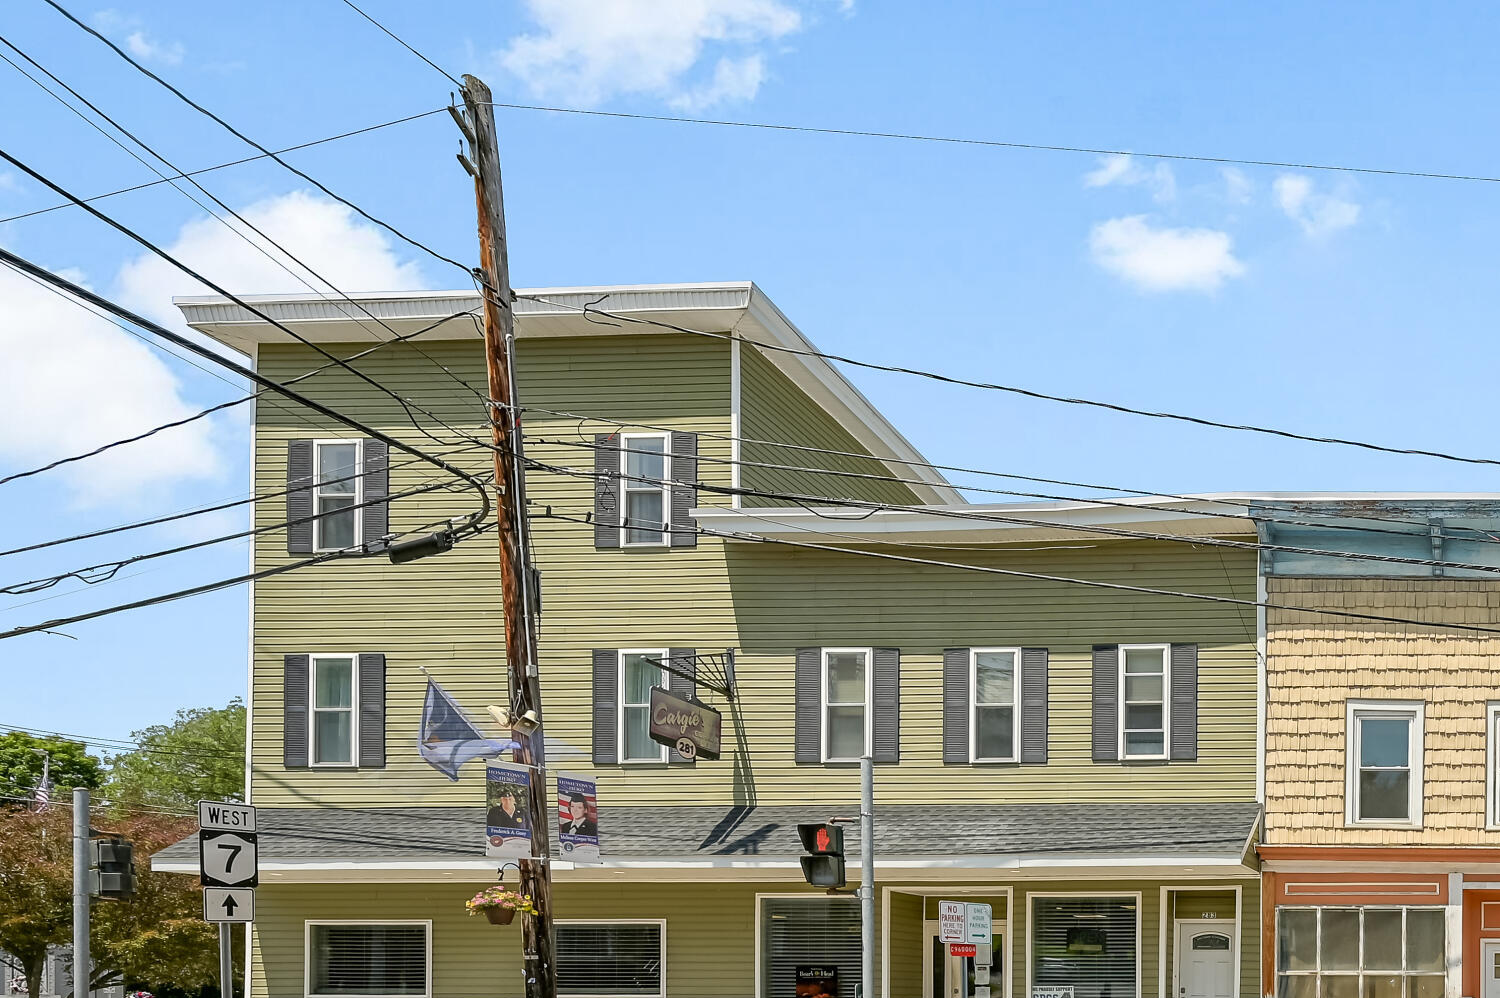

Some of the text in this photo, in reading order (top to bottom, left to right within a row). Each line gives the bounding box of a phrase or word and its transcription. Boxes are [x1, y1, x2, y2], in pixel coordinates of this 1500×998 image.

[680, 742, 694, 755] 281
[488, 769, 526, 779] HOMETOWN
[559, 780, 594, 789] HOMETOWN
[208, 807, 248, 826] WEST
[217, 844, 242, 874] 7
[947, 905, 958, 914] NO
[941, 913, 964, 923] PARKING
